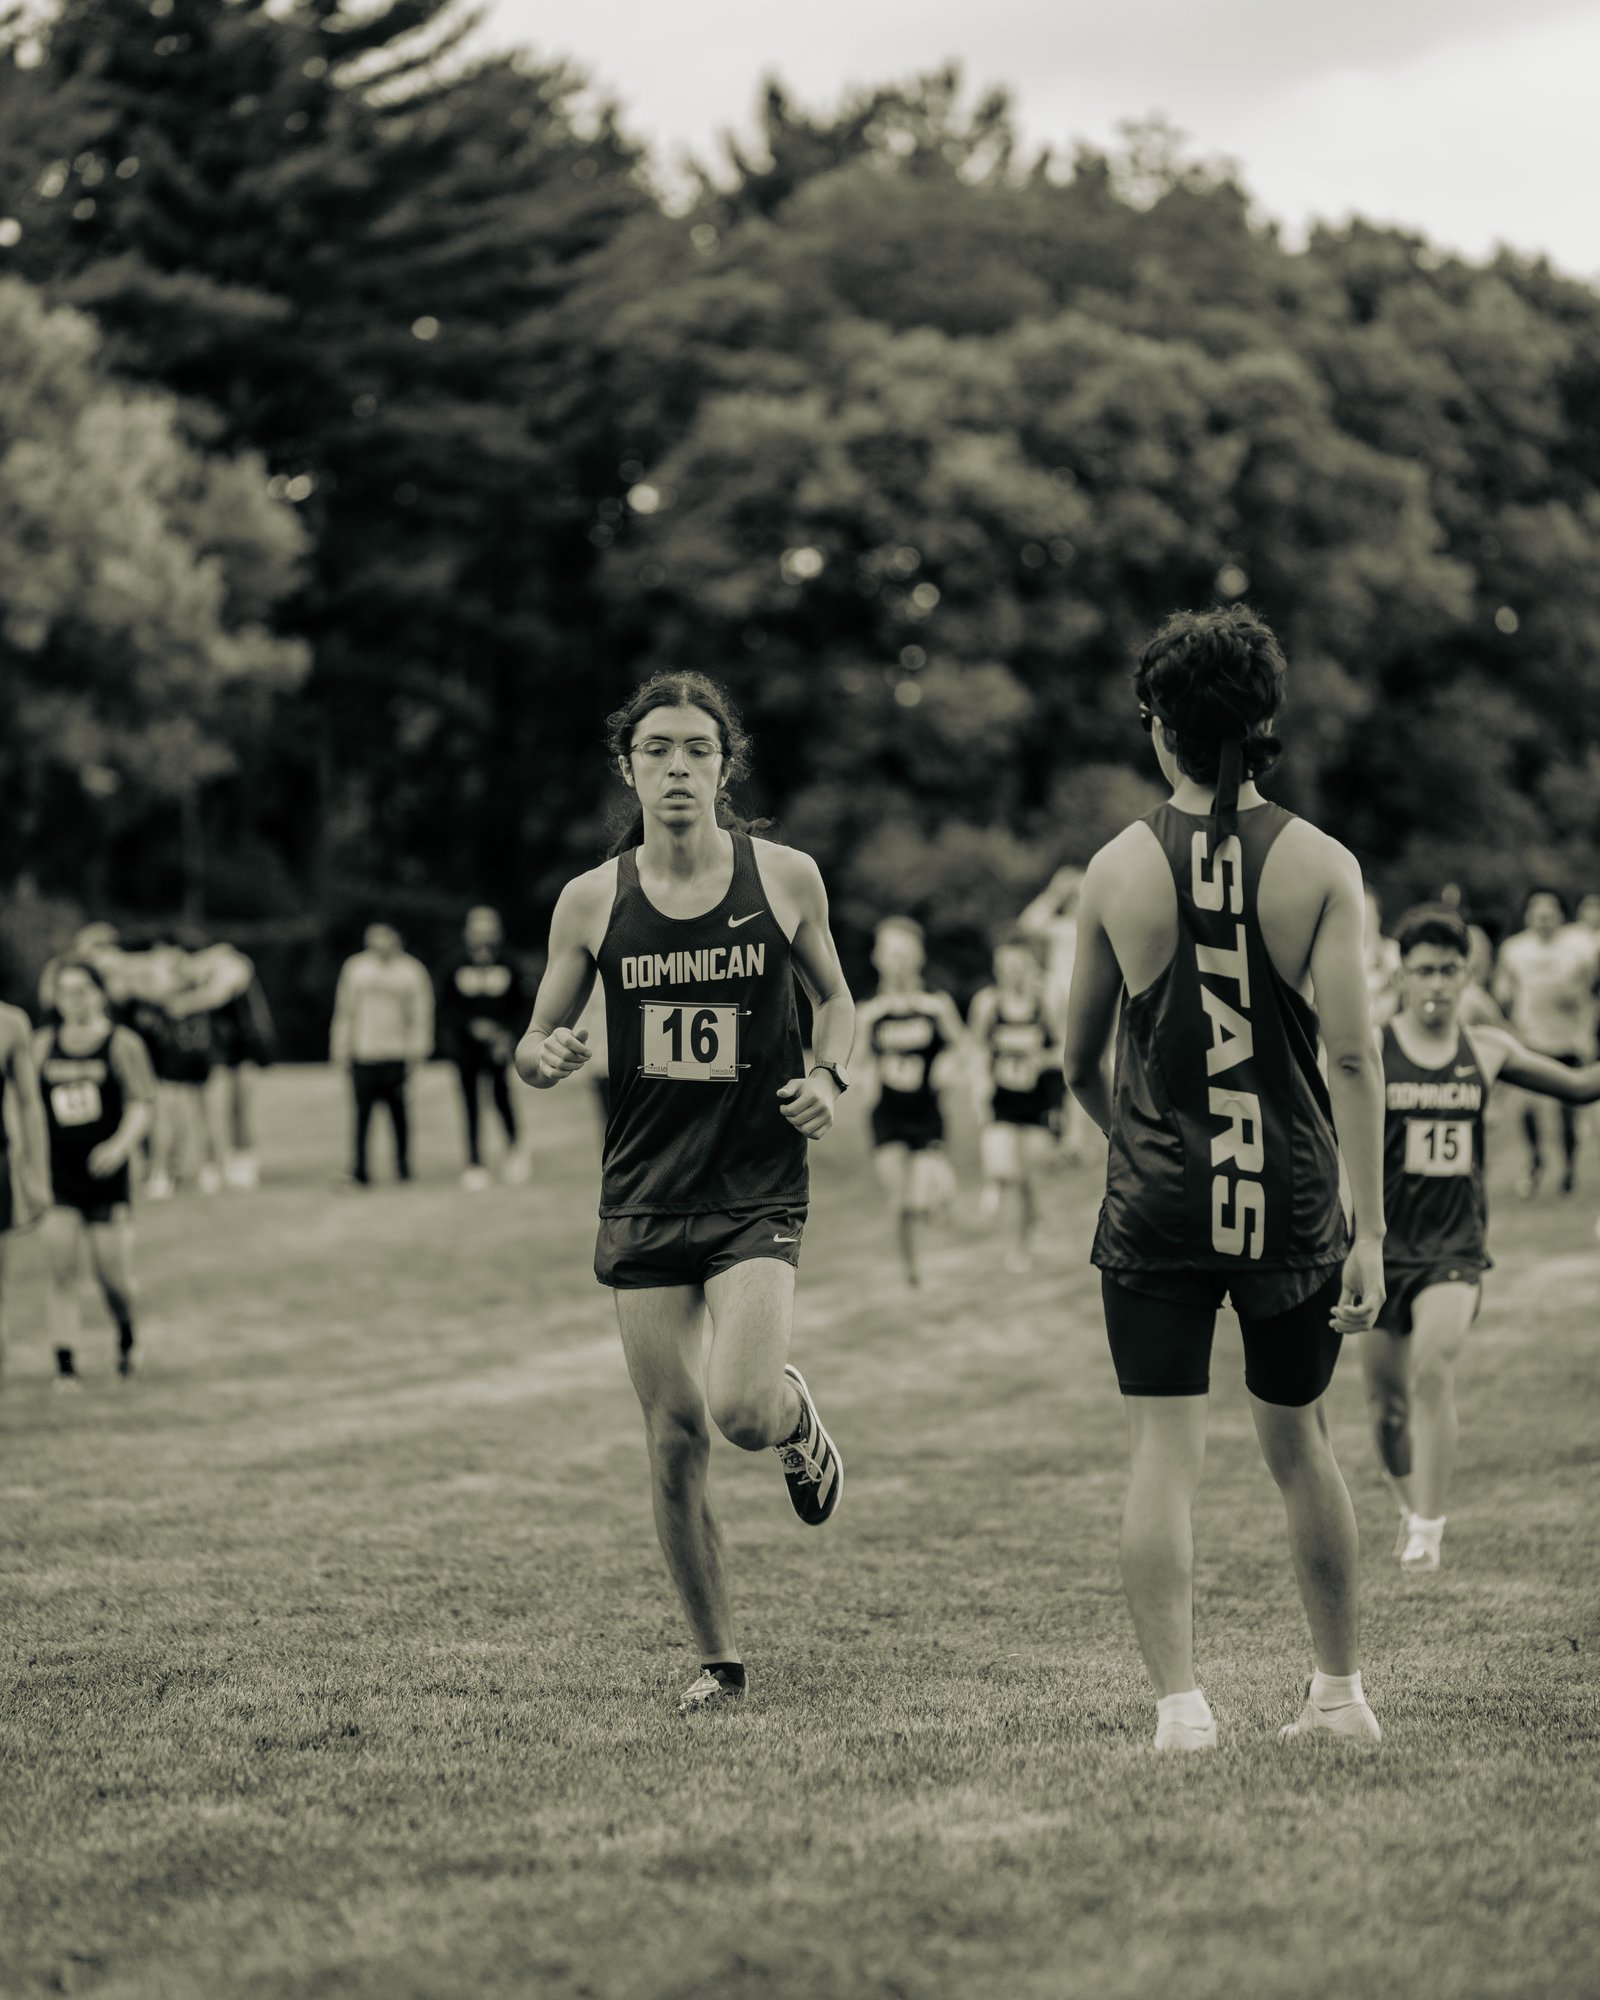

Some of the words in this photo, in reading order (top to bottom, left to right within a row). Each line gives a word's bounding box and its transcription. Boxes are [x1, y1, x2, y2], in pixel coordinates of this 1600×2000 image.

[621, 943, 765, 989] DOMINICAN
[662, 1008, 719, 1064] 16
[1190, 830, 1266, 1260] STARS
[1386, 1082, 1482, 1111] DOMINICAN
[1423, 1126, 1459, 1162] 15
